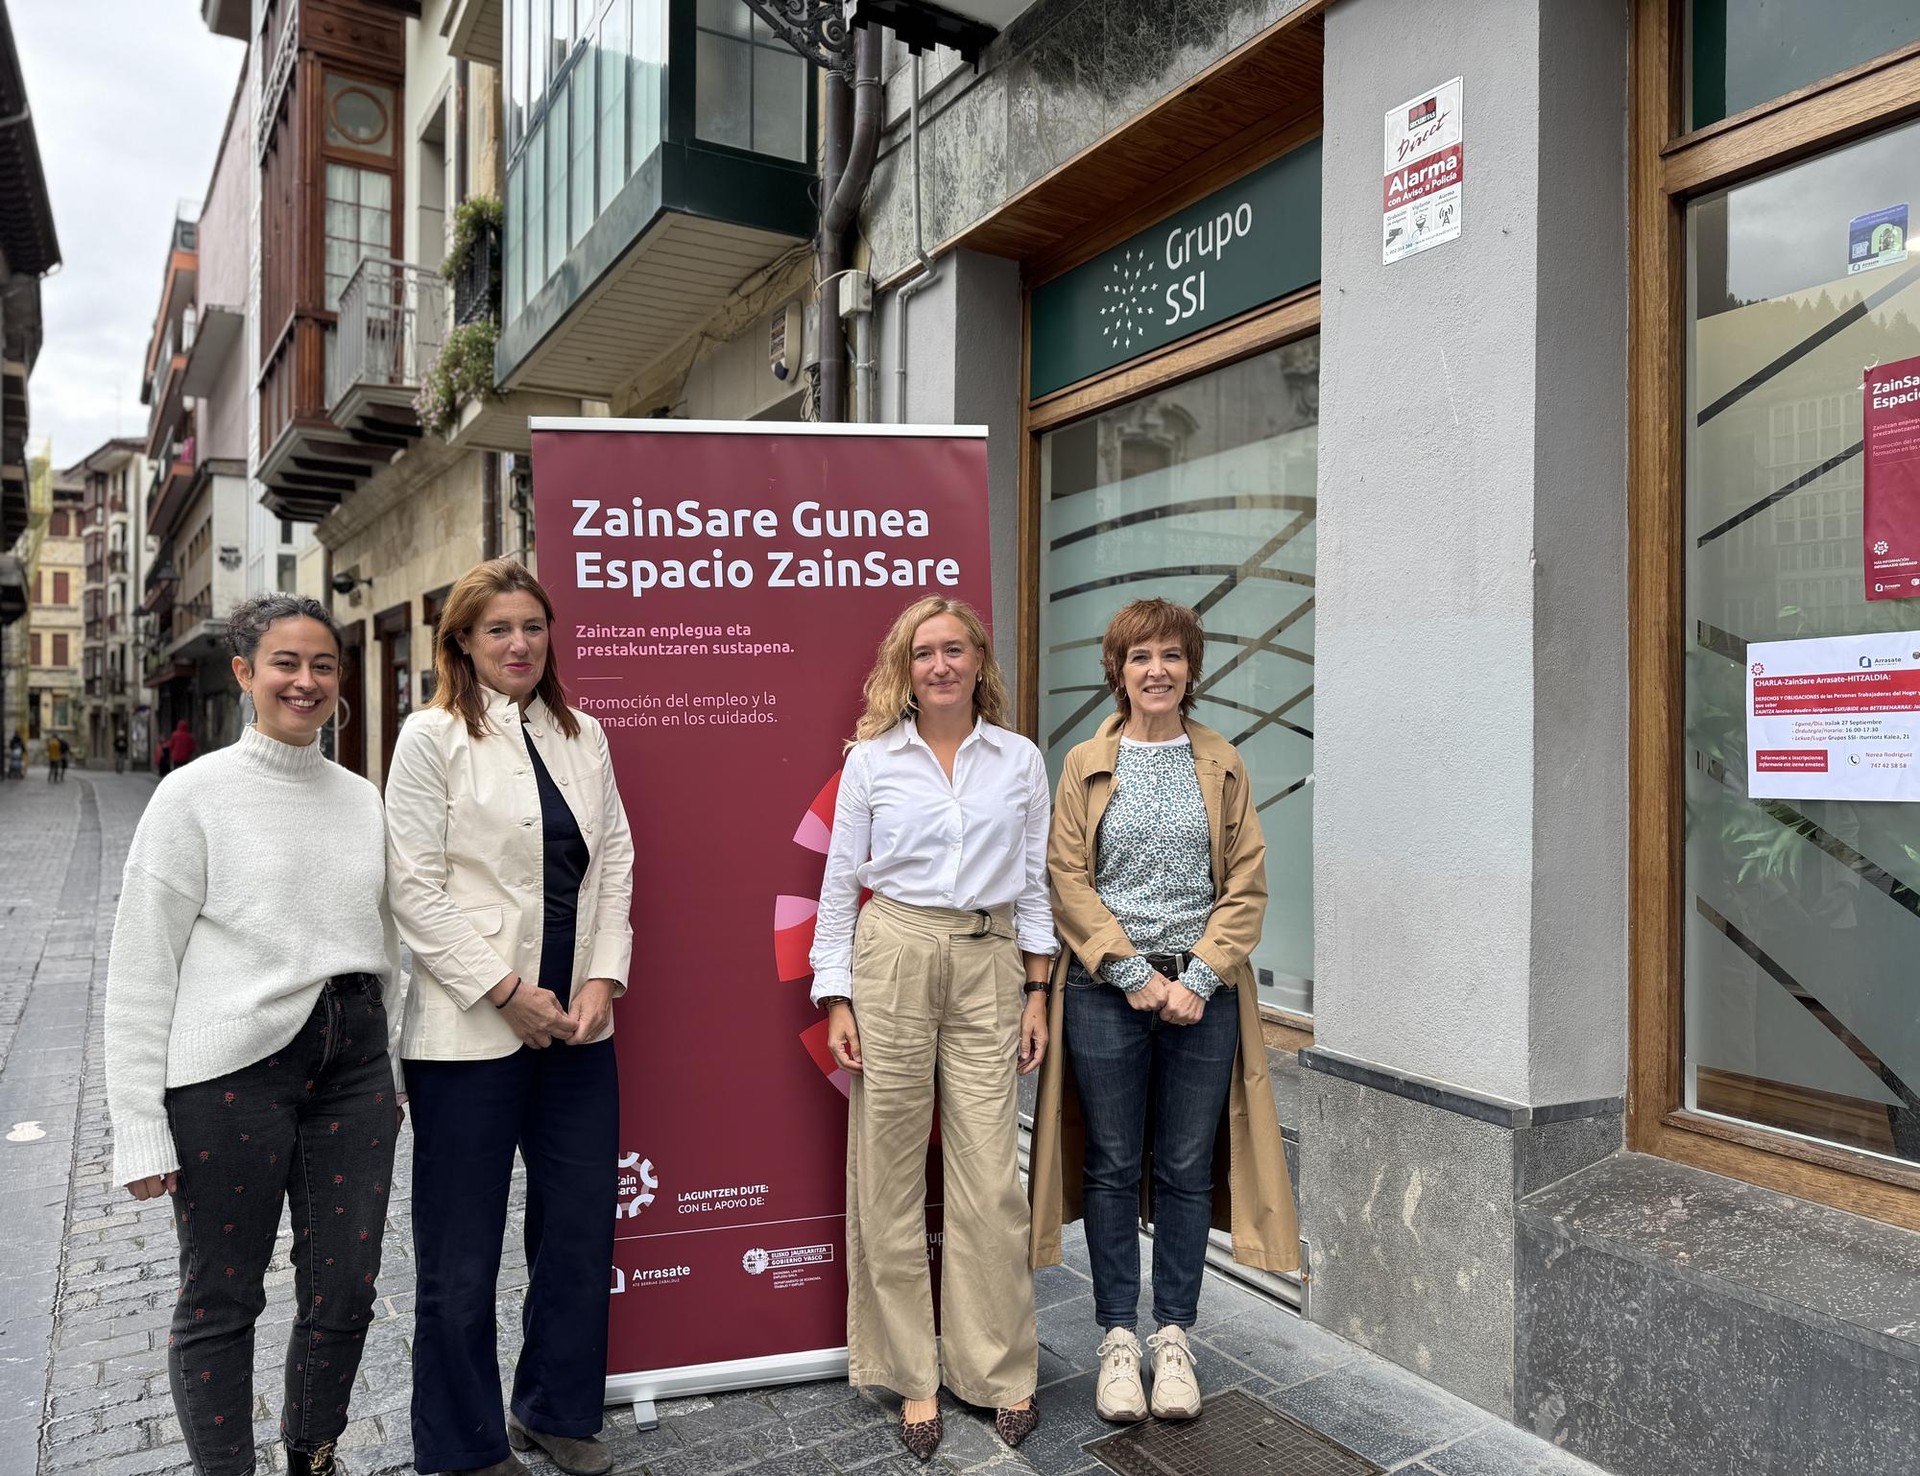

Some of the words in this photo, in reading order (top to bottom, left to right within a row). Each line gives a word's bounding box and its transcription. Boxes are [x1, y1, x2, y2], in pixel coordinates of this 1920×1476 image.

[1409, 112, 1436, 129] SECURITAS
[1397, 110, 1452, 162] Direct
[1388, 155, 1458, 197] Alarma
[1387, 197, 1402, 208] con
[1402, 187, 1424, 201] Aviso
[1431, 172, 1457, 189] Policía
[1165, 202, 1253, 270] Grupo
[1165, 270, 1206, 326] SSI
[1873, 388, 1920, 409] Espaci
[572, 497, 778, 538] ZainSare
[792, 500, 930, 538] Gunea
[575, 548, 754, 598] Espacio
[767, 548, 961, 588] ZainSare
[575, 624, 646, 638] Zaintzan
[650, 623, 722, 640] enplegua
[726, 623, 752, 637] eta
[576, 641, 709, 660] prestakuntzaren
[712, 641, 795, 657] sustapena.
[1754, 678, 1815, 687] CHARLA-ZainSare
[579, 694, 662, 710] Promoción
[665, 693, 690, 708] del
[692, 692, 748, 709] empleo
[751, 695, 760, 707] y
[763, 691, 776, 706] la
[598, 713, 657, 728] rmación
[661, 715, 680, 726] en
[684, 711, 705, 725] los
[709, 710, 778, 725] cuidados.
[1849, 719, 1882, 727] Septiembre
[677, 1186, 738, 1202] LAGUNTZEN
[740, 1184, 769, 1196] DUTE:
[677, 1203, 699, 1214] CON
[701, 1202, 713, 1212] EL
[713, 1198, 748, 1211] APOYO
[749, 1196, 765, 1207] DE:
[771, 1250, 790, 1259] EUSKO
[771, 1256, 803, 1266] GOBIERNO
[803, 1254, 823, 1262] VASCO
[632, 1265, 691, 1281] Arrasate
